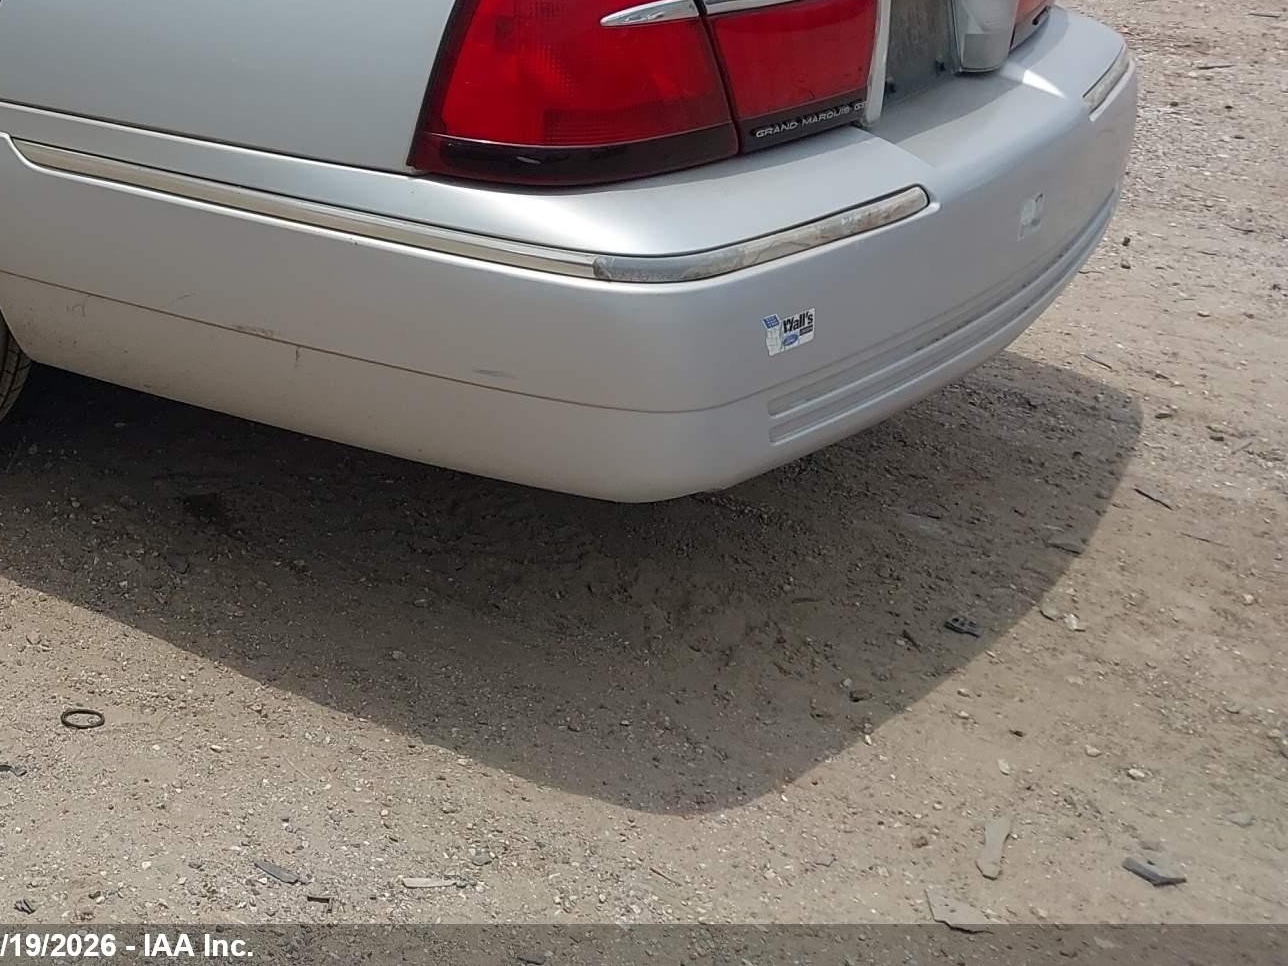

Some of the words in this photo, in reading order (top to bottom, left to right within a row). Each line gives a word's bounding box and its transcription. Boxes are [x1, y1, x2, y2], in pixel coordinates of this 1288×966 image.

[755, 121, 798, 138] GRAND
[802, 105, 851, 126] MARQUIS
[782, 311, 814, 334] Wall's
